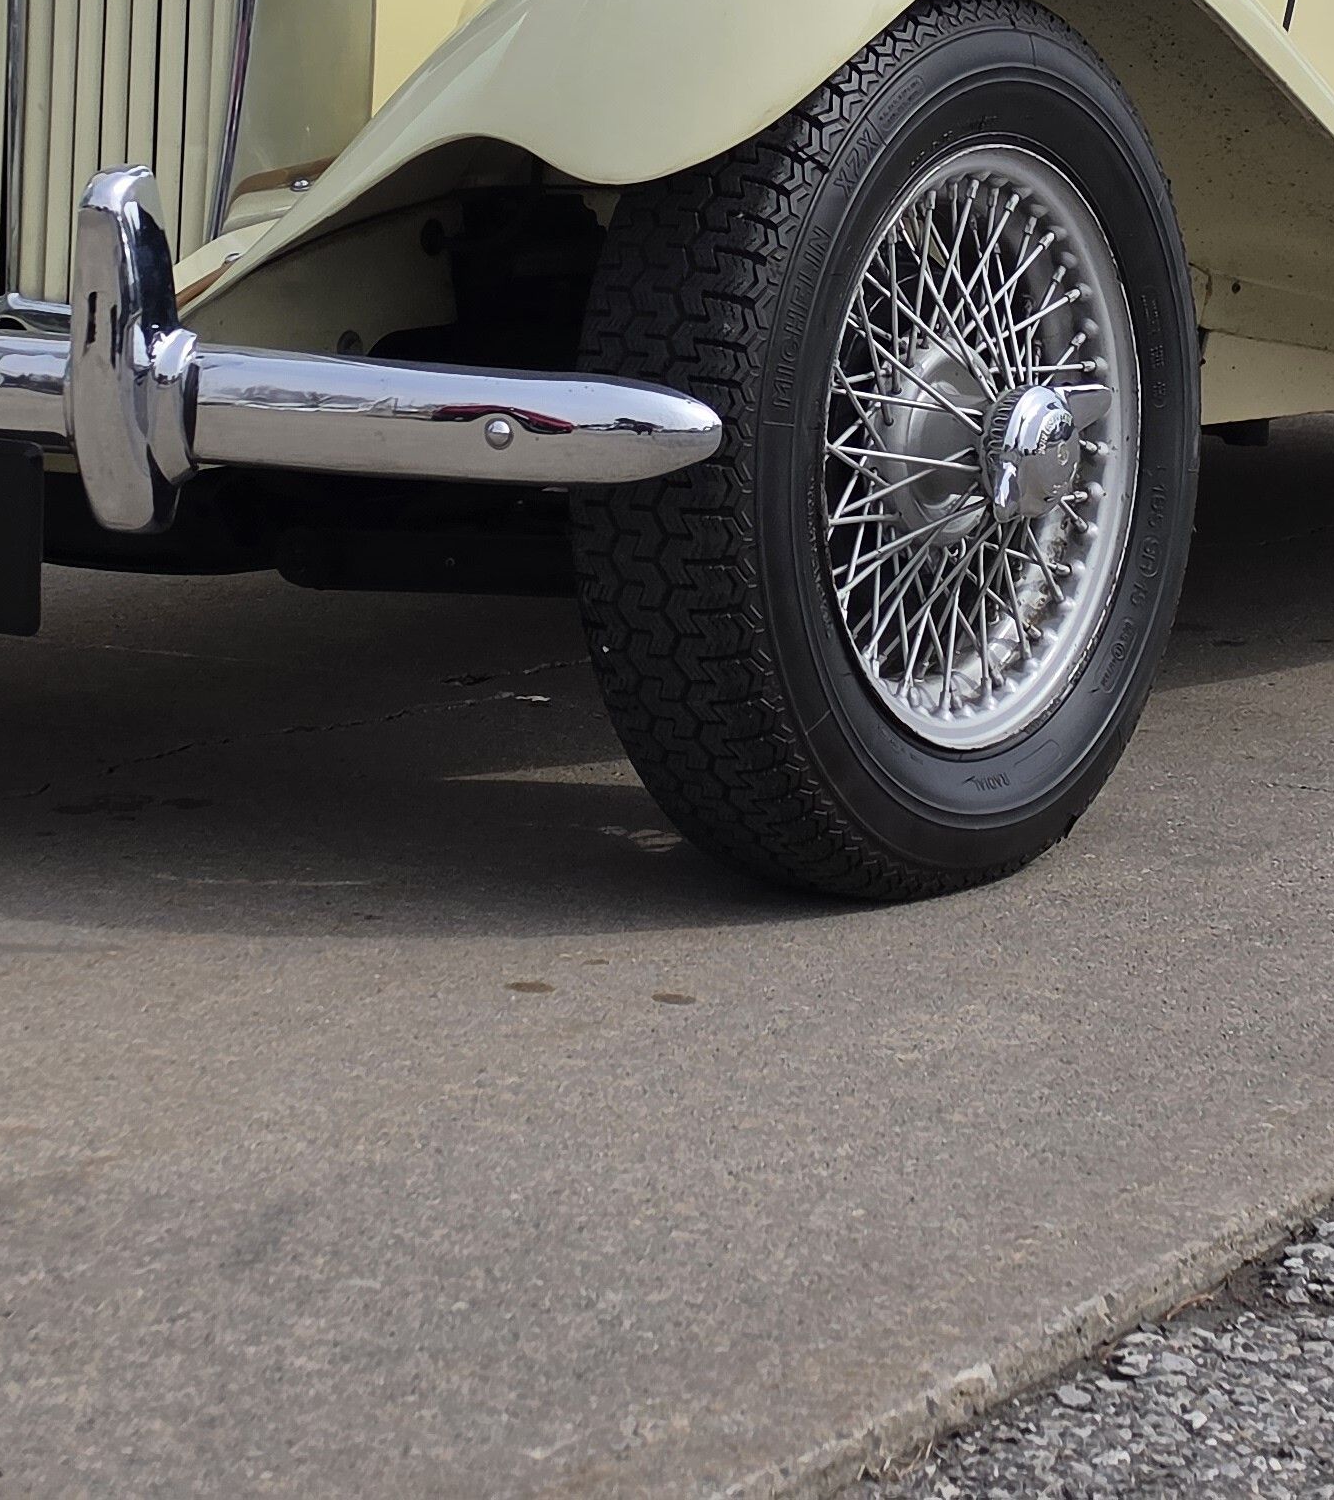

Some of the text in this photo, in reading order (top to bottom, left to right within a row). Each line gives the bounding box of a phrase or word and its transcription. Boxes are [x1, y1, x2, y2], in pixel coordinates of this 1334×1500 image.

[774, 225, 832, 410] MICHELIN
[833, 127, 881, 199] XZX
[971, 772, 1009, 791] RADIAL
